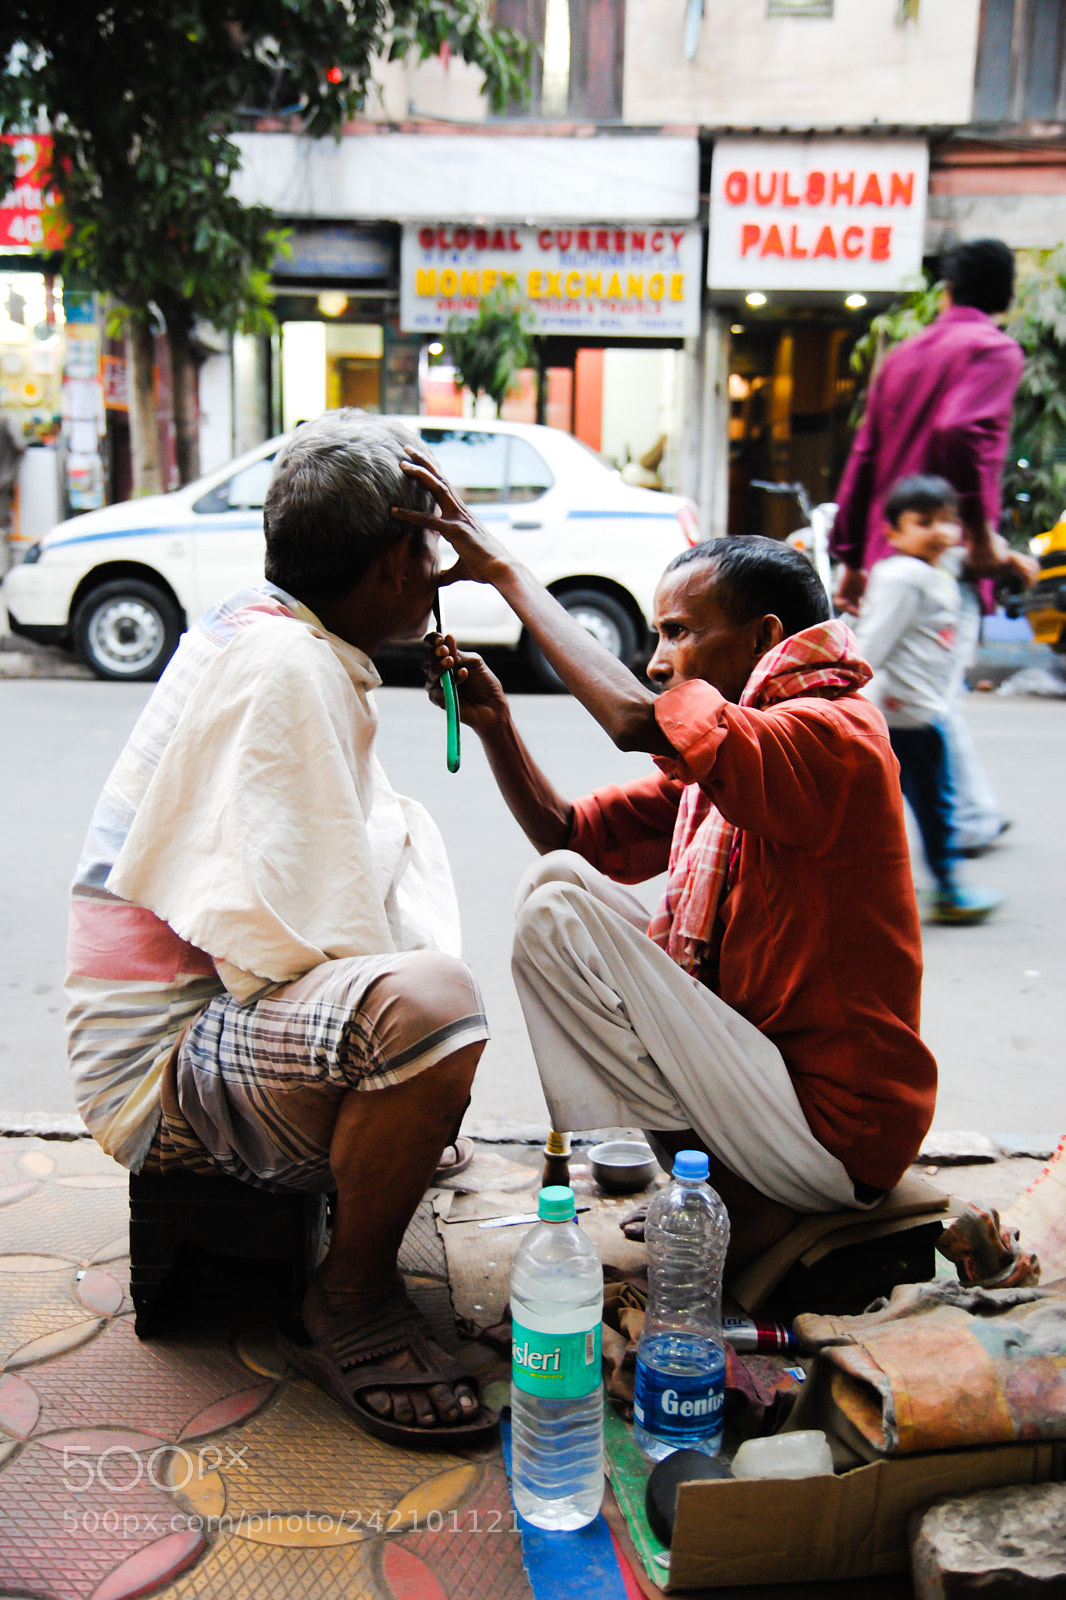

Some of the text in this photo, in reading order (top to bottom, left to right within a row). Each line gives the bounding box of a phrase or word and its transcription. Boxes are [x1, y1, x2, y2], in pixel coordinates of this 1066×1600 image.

[725, 170, 915, 207] GULSHAN
[418, 227, 685, 253] GLOBAL CURRENCY
[740, 224, 893, 261] PALACE
[527, 269, 685, 302] EXCHANGE
[512, 1338, 560, 1371] isleri
